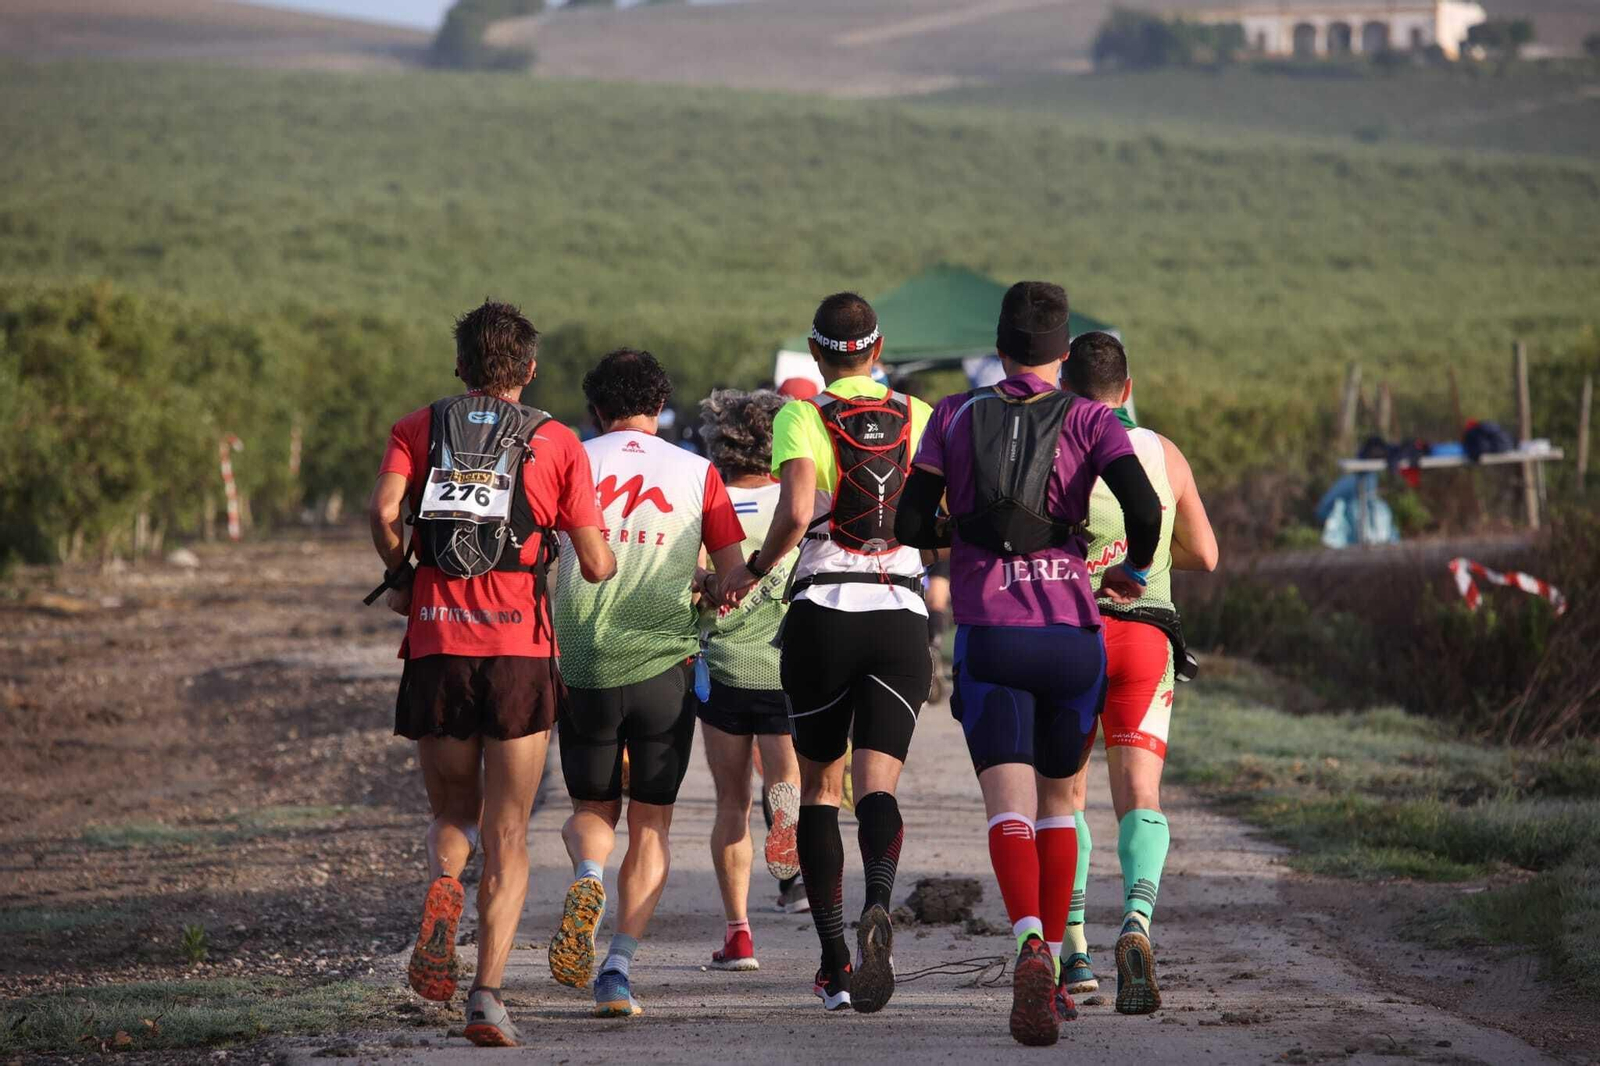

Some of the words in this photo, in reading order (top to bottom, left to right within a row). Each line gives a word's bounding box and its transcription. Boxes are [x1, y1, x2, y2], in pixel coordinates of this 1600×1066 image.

[438, 483, 491, 507] 276
[602, 529, 666, 546] EREZ
[743, 567, 789, 615] JEREZ
[419, 606, 523, 625] ANTITAURINO
